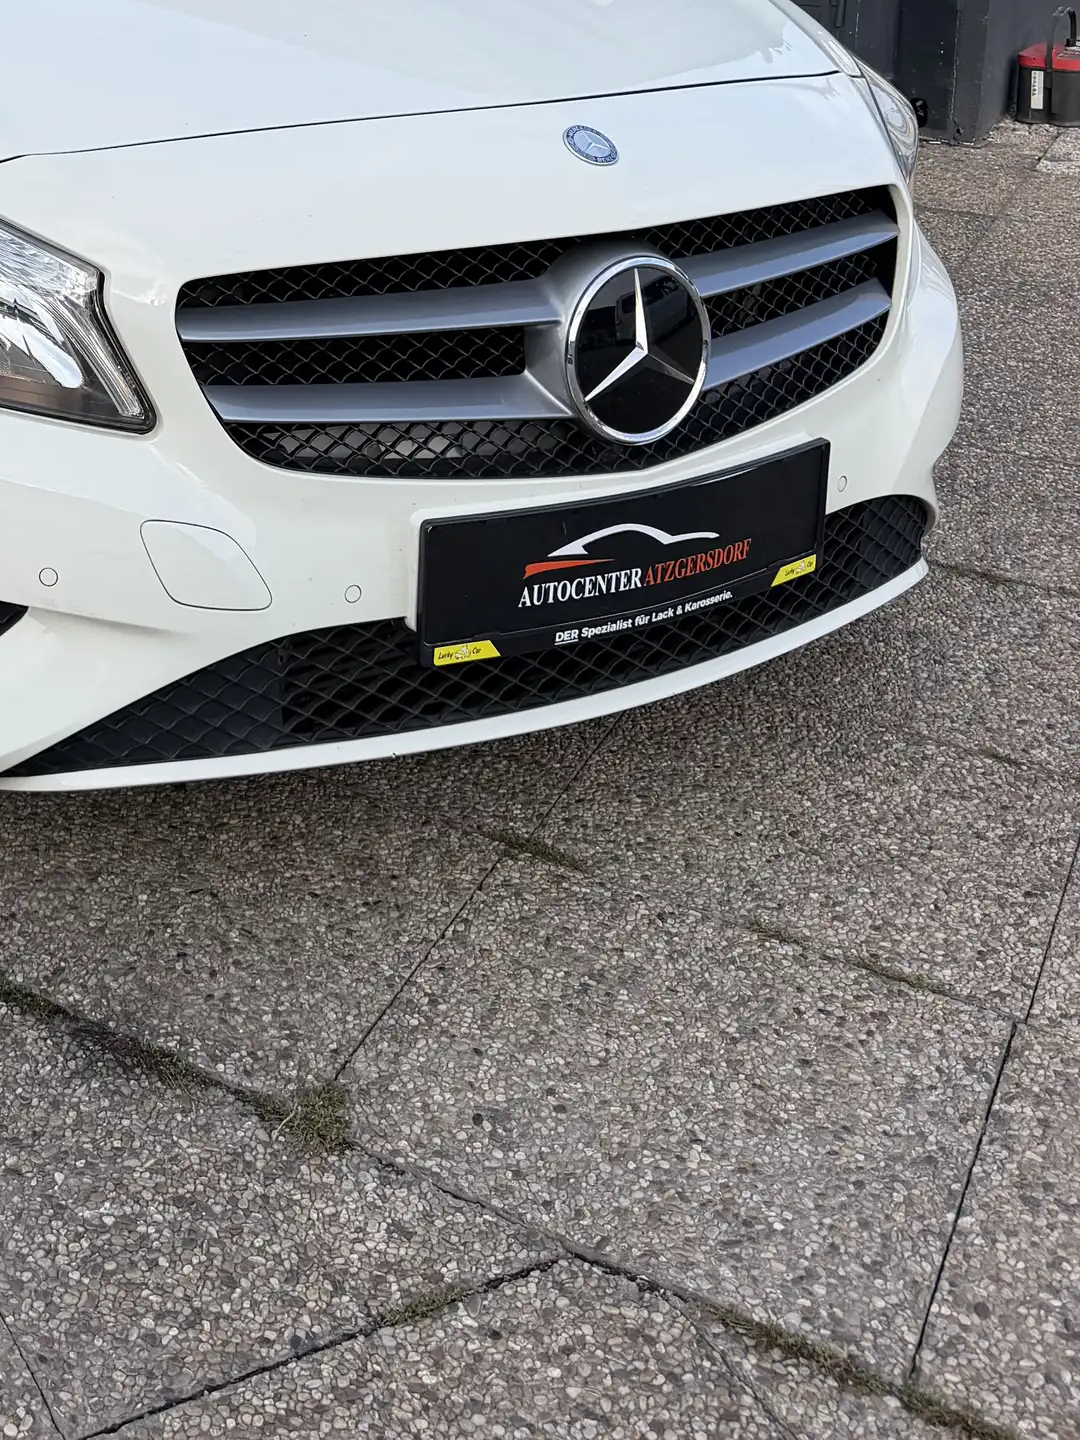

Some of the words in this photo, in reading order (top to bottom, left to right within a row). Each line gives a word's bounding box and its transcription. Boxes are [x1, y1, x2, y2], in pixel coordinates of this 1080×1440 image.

[517, 567, 642, 609] AUTOCENTER
[643, 538, 752, 587] ATZGERSDORF
[555, 629, 579, 643] DER
[581, 618, 633, 639] Spezialist
[634, 615, 650, 627] für
[651, 608, 674, 623] Lack
[676, 604, 683, 615] &
[684, 589, 733, 613] Karosserie.
